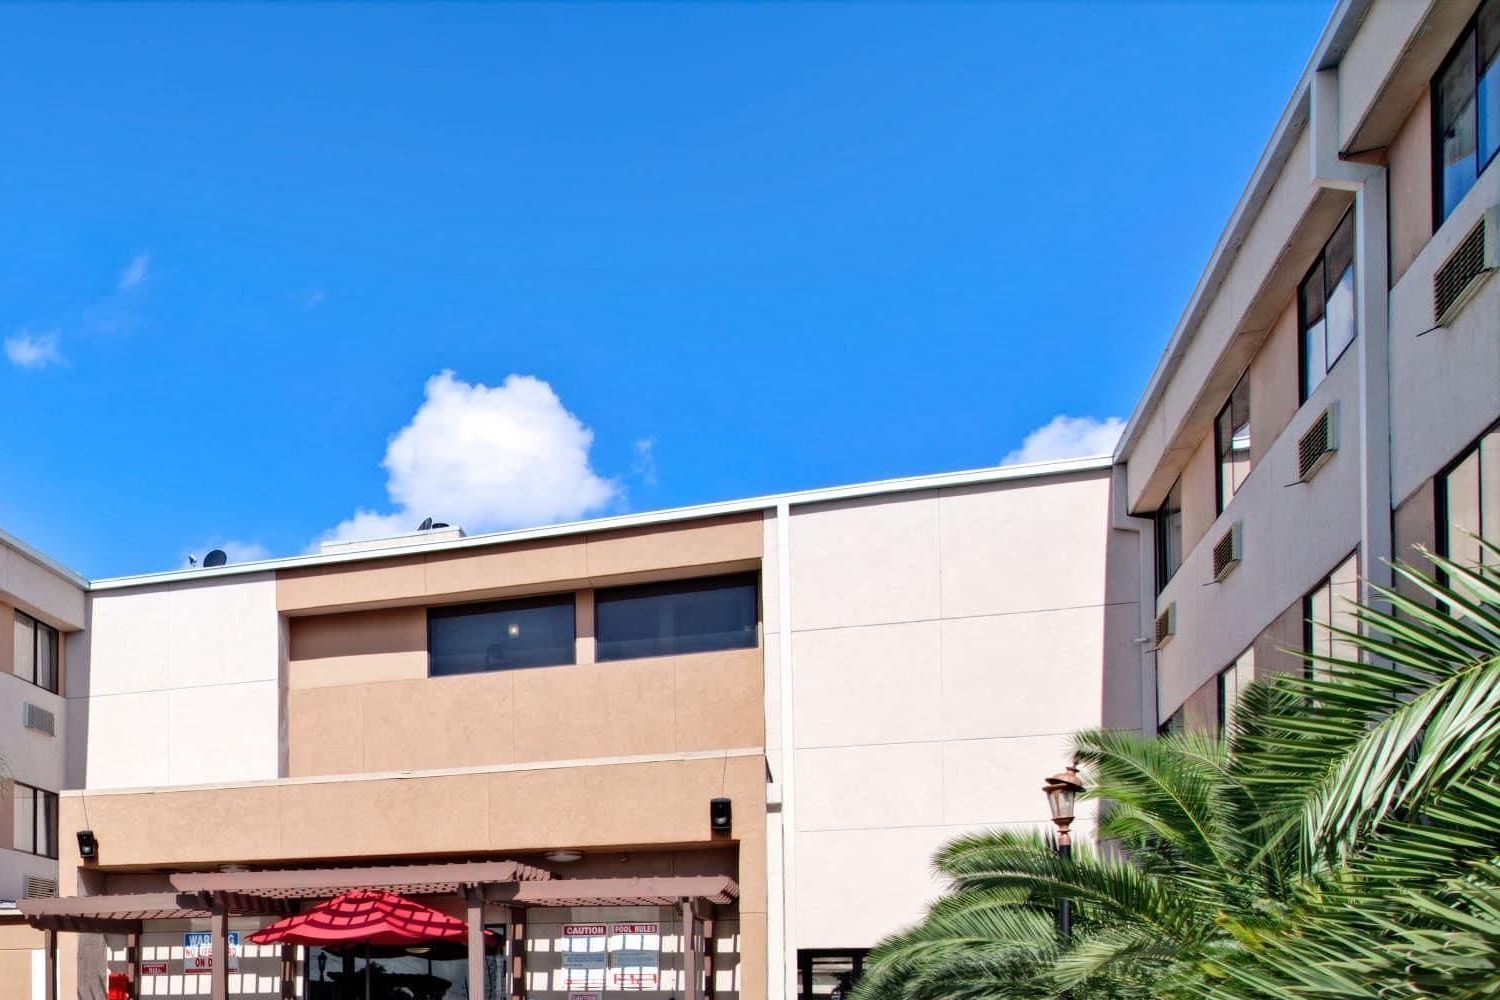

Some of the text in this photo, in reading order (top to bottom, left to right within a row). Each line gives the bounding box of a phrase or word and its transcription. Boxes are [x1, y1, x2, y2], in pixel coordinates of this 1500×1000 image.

[566, 926, 604, 935] CAUTION
[635, 925, 656, 933] RULES
[189, 934, 235, 947] WARG
[185, 948, 195, 957] NO
[196, 958, 205, 968] ON
